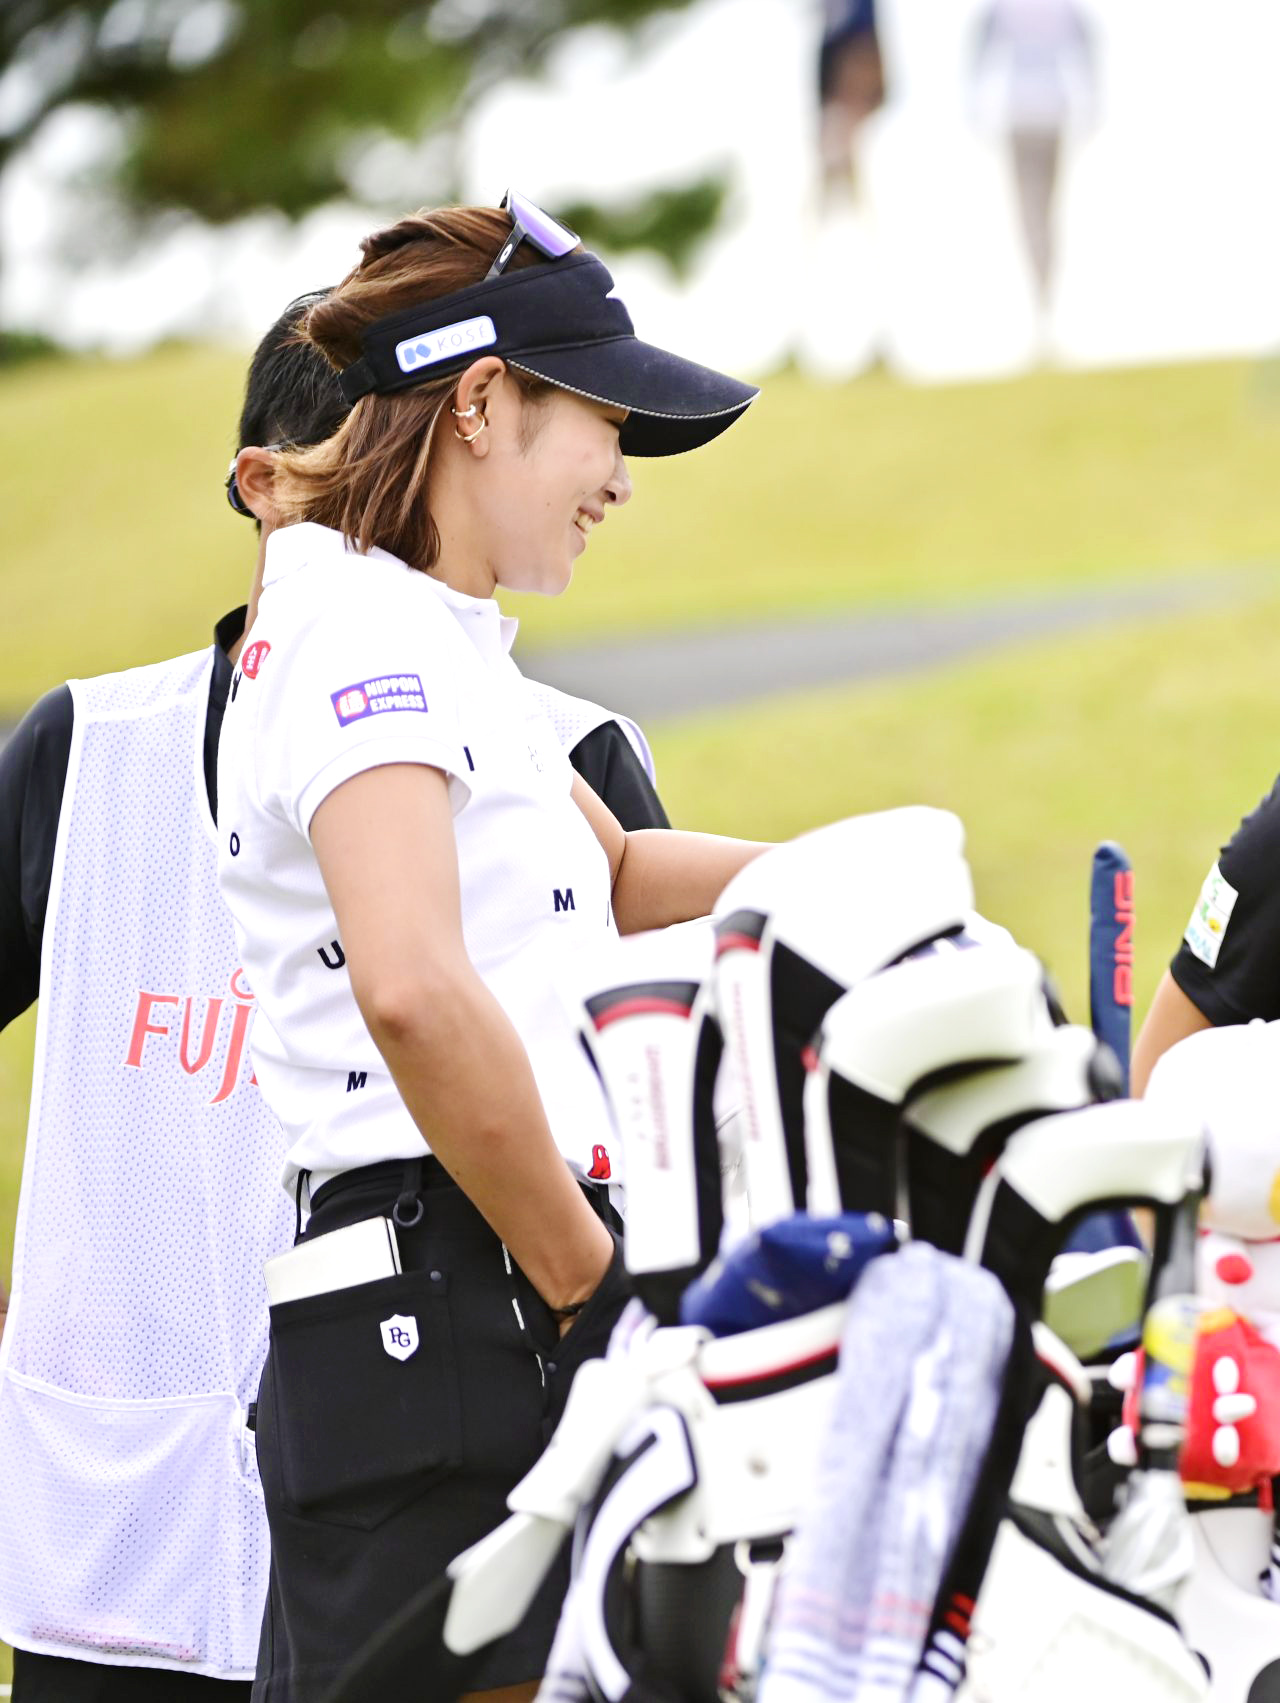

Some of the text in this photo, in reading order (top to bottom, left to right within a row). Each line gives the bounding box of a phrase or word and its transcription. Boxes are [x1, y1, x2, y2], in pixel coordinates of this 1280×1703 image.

[364, 677, 421, 698] NIPPON
[369, 694, 425, 713] EXPRESS
[123, 990, 259, 1104] FUJ
